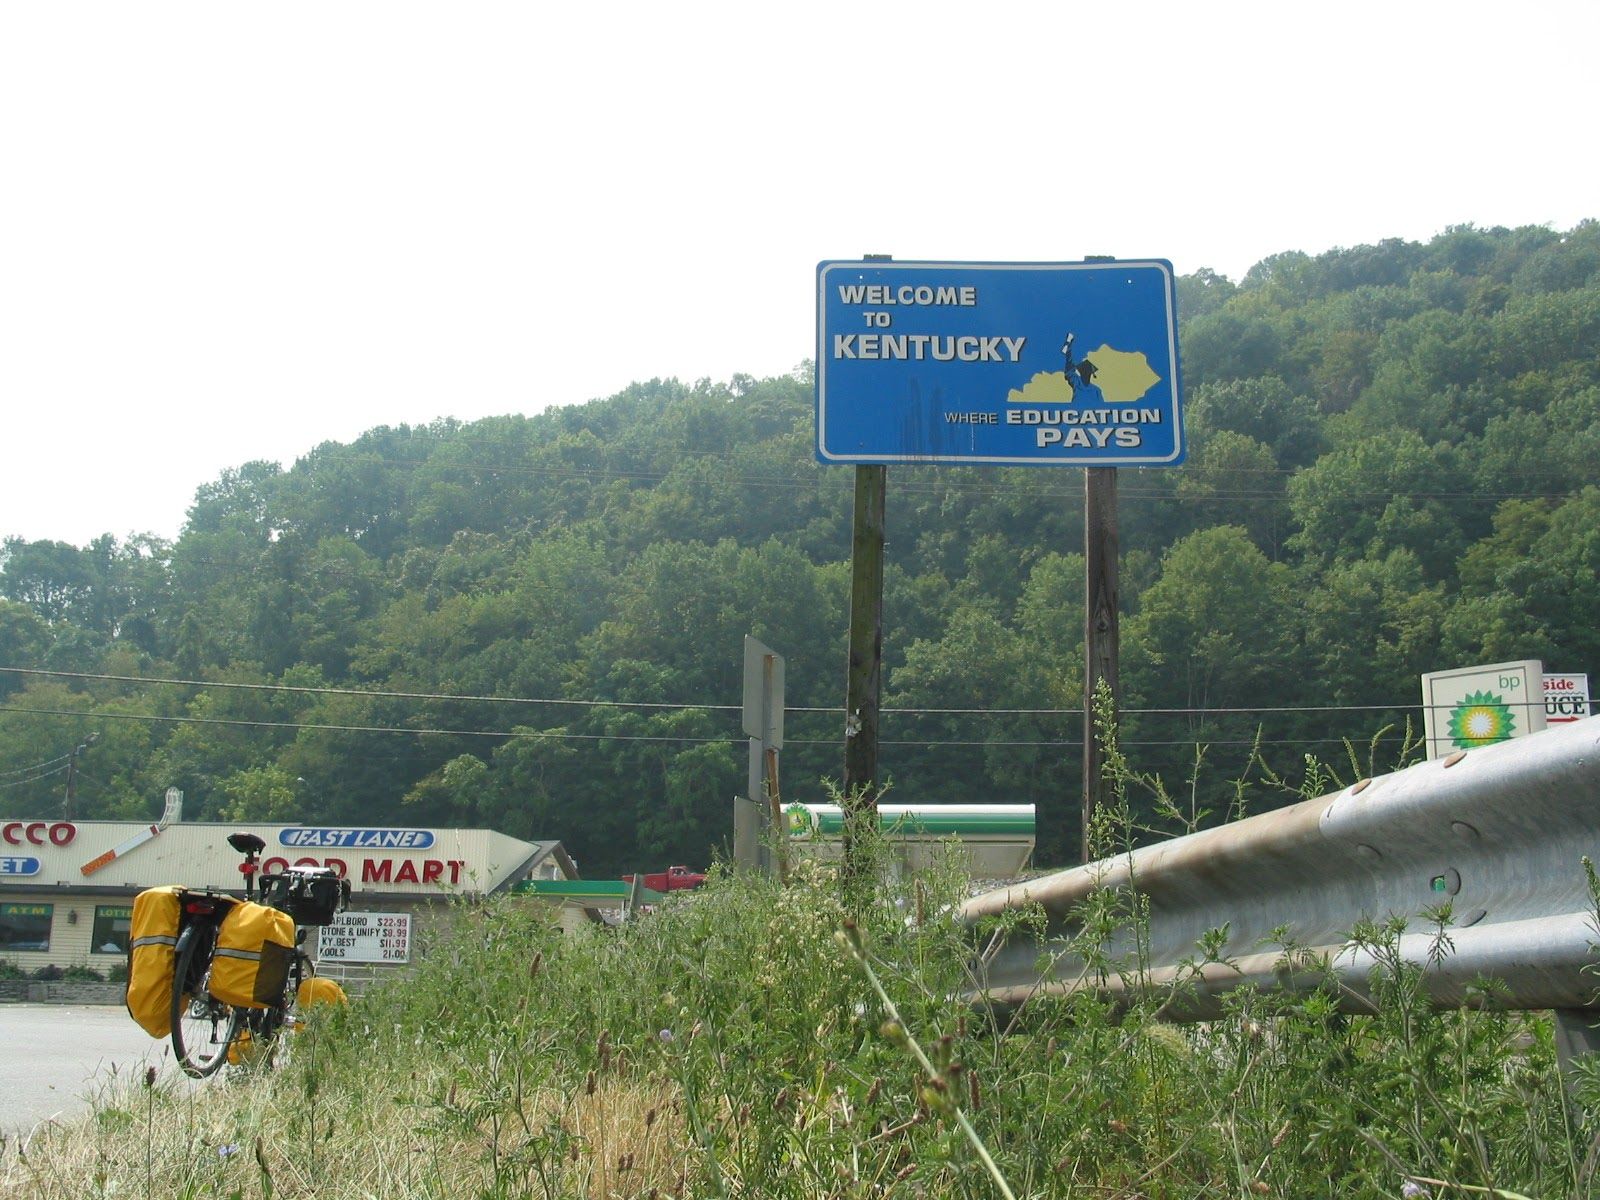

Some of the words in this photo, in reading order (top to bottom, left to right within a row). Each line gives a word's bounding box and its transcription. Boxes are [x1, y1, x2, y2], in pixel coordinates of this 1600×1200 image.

[838, 285, 976, 306] WELCOME
[862, 311, 891, 328] TO
[833, 334, 1026, 362] KENTUCKY
[944, 412, 998, 425] WHERE
[1006, 409, 1161, 425] EDUCATION
[1036, 427, 1141, 448] PAYS
[1498, 675, 1520, 691] bp
[1543, 679, 1574, 690] side
[1544, 696, 1585, 715] UCE
[2, 822, 77, 846] CCO
[299, 830, 352, 846] FAST
[354, 831, 416, 847] LANE
[362, 859, 464, 884] MART
[7, 906, 45, 915] ATM
[330, 917, 367, 926] ARLBORO
[377, 918, 407, 927] $22.99
[348, 928, 354, 936] &
[356, 928, 380, 937] UNIFY
[380, 939, 406, 948] $11.99
